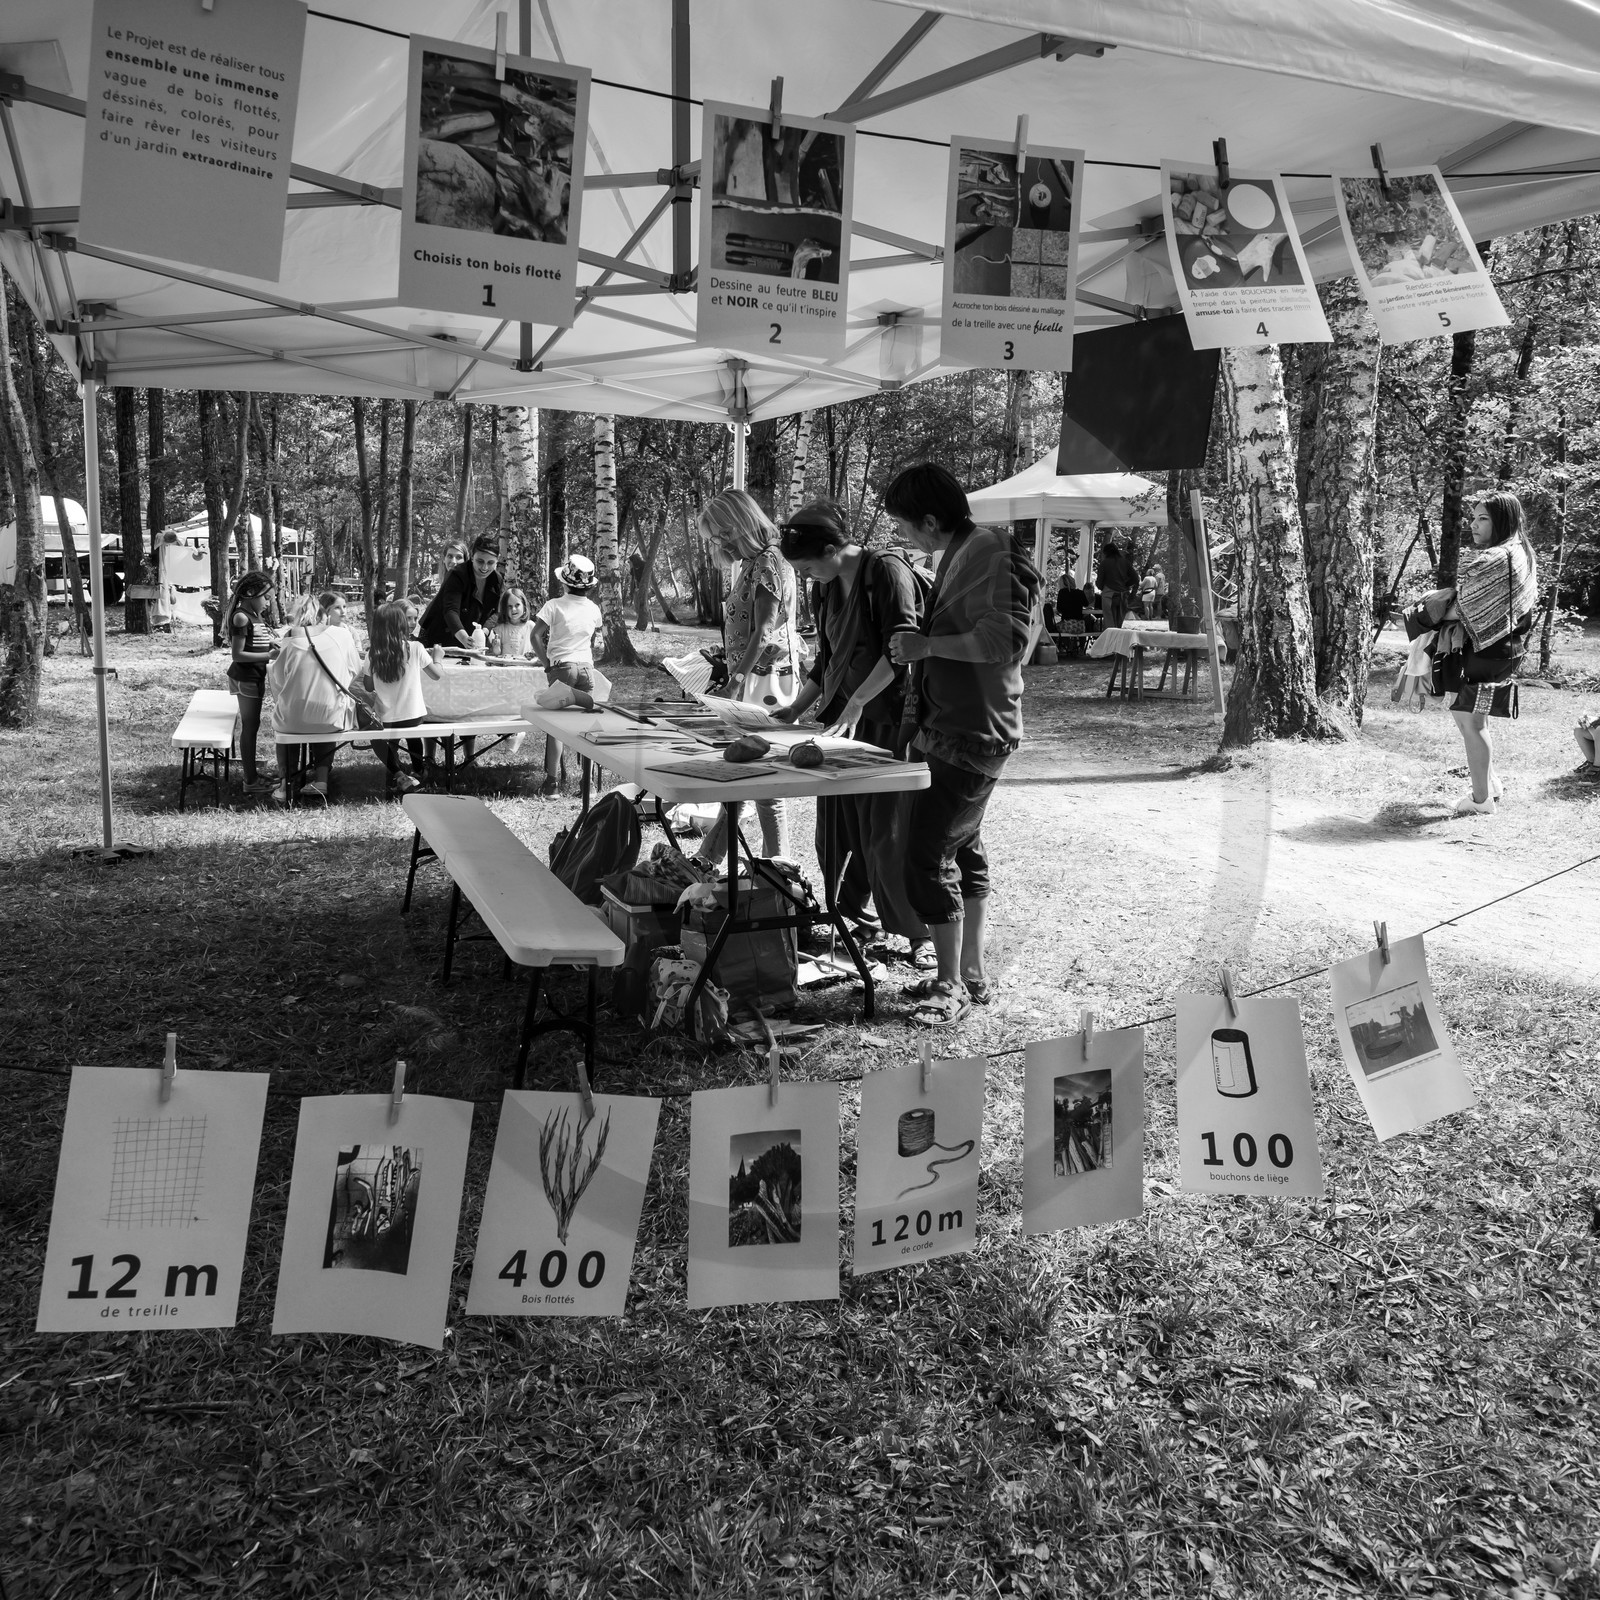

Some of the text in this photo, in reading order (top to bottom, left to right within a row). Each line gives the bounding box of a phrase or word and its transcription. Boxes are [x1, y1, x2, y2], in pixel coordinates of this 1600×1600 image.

[107, 26, 286, 82] Le Projet est de réaliser tous
[106, 49, 280, 100] ensemble une immense
[104, 70, 281, 122] vague de bois flottés,
[102, 88, 280, 141] déssinés, colorés, pour
[101, 108, 278, 161] faire rêver les visiteurs
[100, 130, 274, 180] d'un jardin extraordinaire
[414, 250, 562, 280] Choisis ton bois flotté
[482, 284, 496, 307] 1
[710, 277, 838, 302] Dessine au feutre BLEU
[1405, 280, 1453, 292] Rendez-vous
[711, 295, 837, 318] et NOIR ce qu'il t'inspire
[952, 301, 981, 310] Accroche
[982, 302, 993, 310] ton
[994, 302, 1007, 312] bois
[1249, 297, 1277, 306] peinture
[1386, 296, 1405, 304] jardin
[1196, 308, 1234, 317] amuse-toi
[1438, 312, 1451, 327] 5
[769, 323, 782, 344] 2
[952, 318, 962, 328] de
[964, 318, 972, 328] la
[974, 320, 996, 329] treille
[998, 322, 1015, 330] avec
[1034, 320, 1063, 334] ficelle
[1256, 322, 1269, 337] 4
[1004, 340, 1014, 360] 3
[1201, 1131, 1294, 1168] 100
[1210, 1172, 1290, 1184] bouchons de liège
[901, 1240, 934, 1255] de corde
[67, 1254, 218, 1300] 12 m
[498, 1250, 606, 1288] 400
[521, 1294, 575, 1304] Bois flottés
[100, 1304, 179, 1318] de treille
